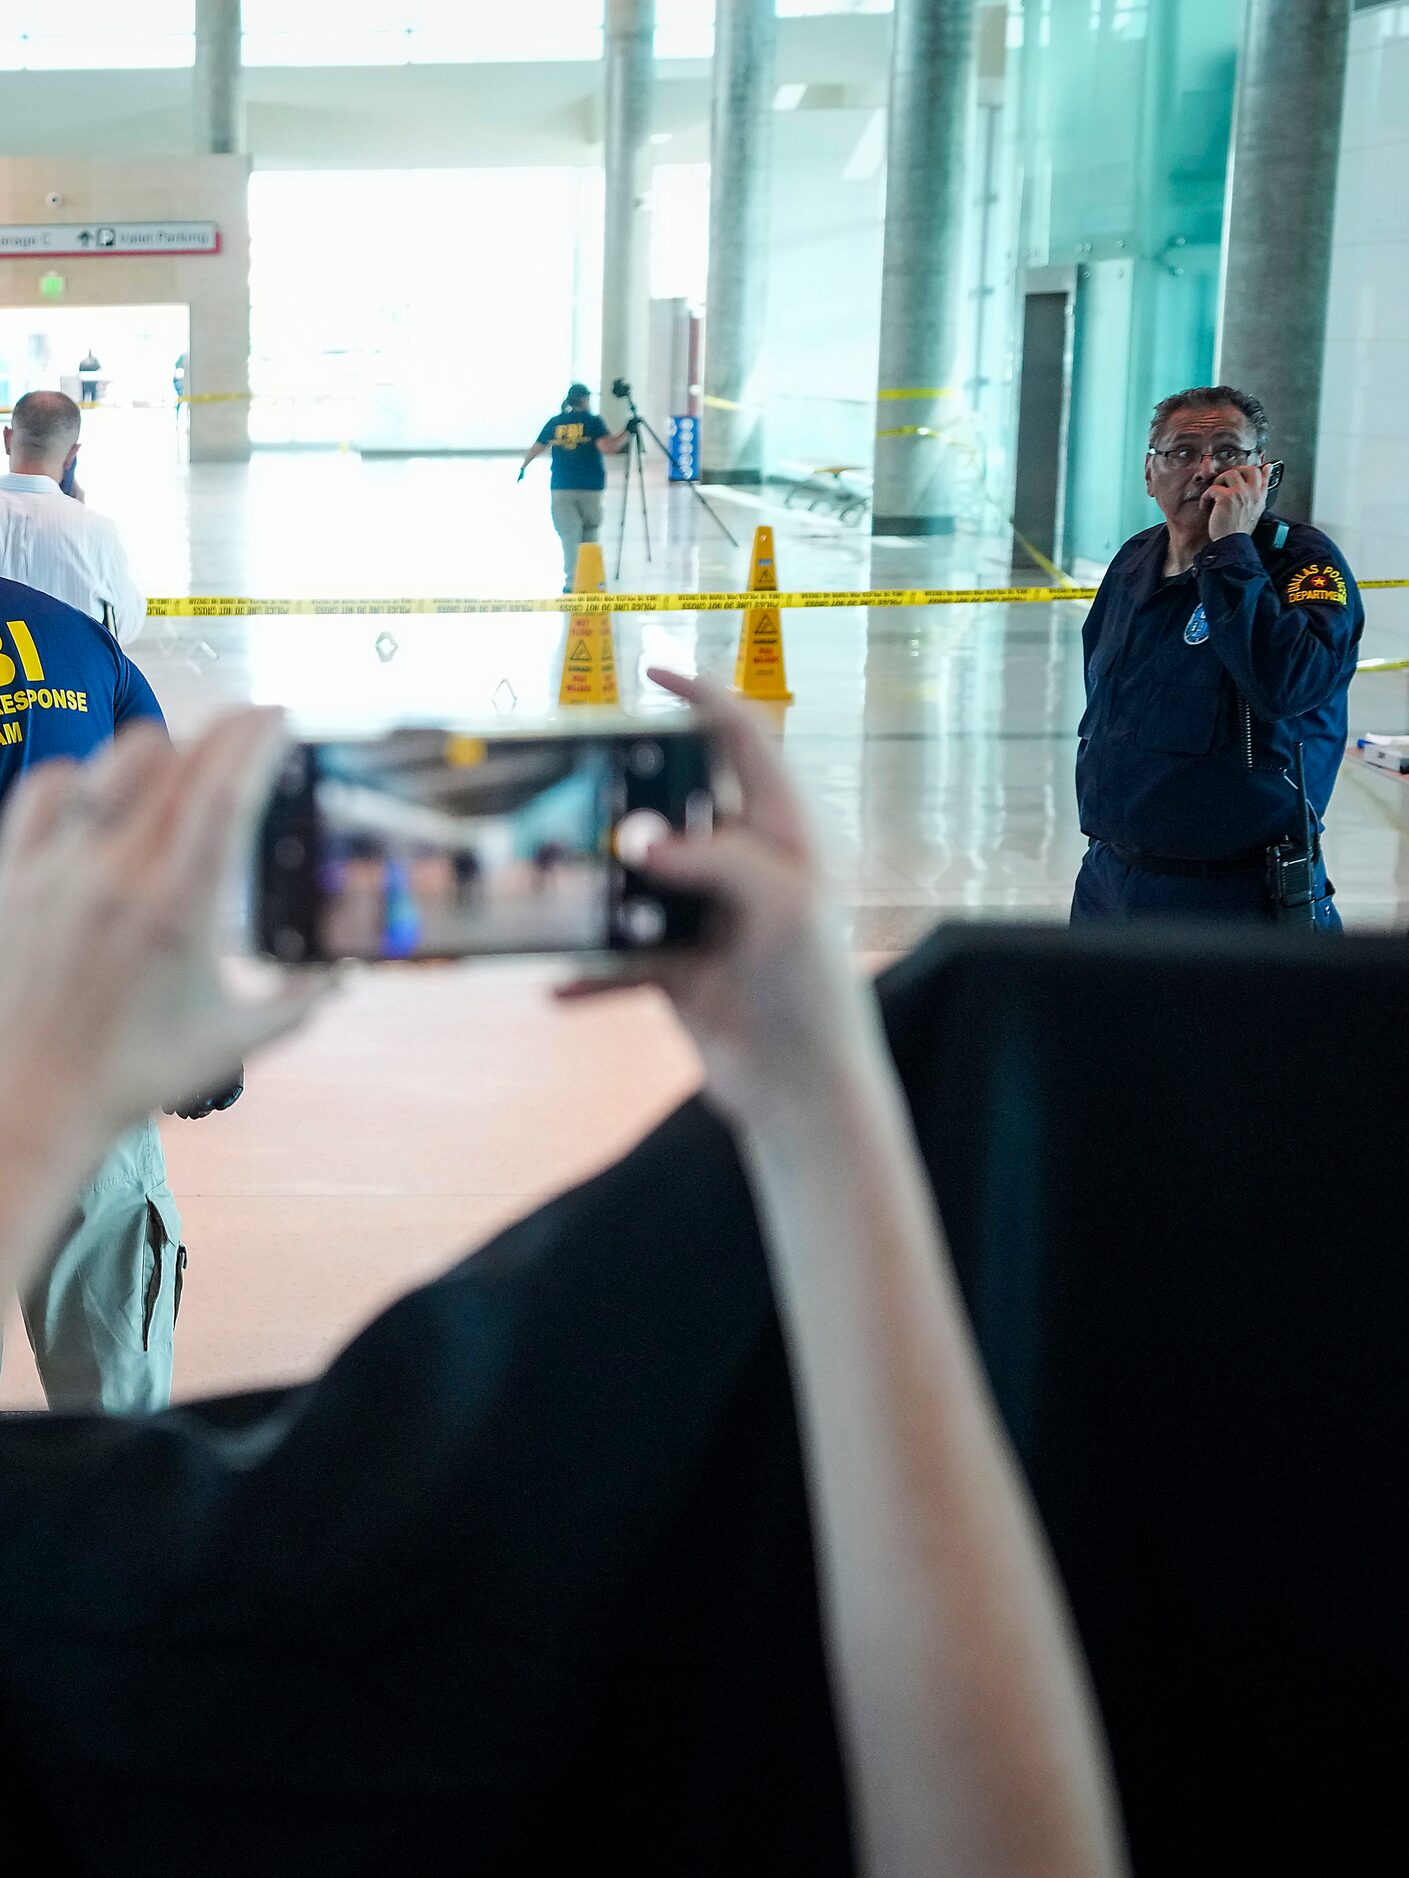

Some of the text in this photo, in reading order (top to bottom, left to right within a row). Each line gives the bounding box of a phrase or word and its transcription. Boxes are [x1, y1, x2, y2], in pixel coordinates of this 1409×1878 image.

[159, 231, 208, 244] Parking
[555, 423, 584, 439] FBI
[1287, 564, 1319, 593] DALLAS
[146, 607, 168, 615] POLIC
